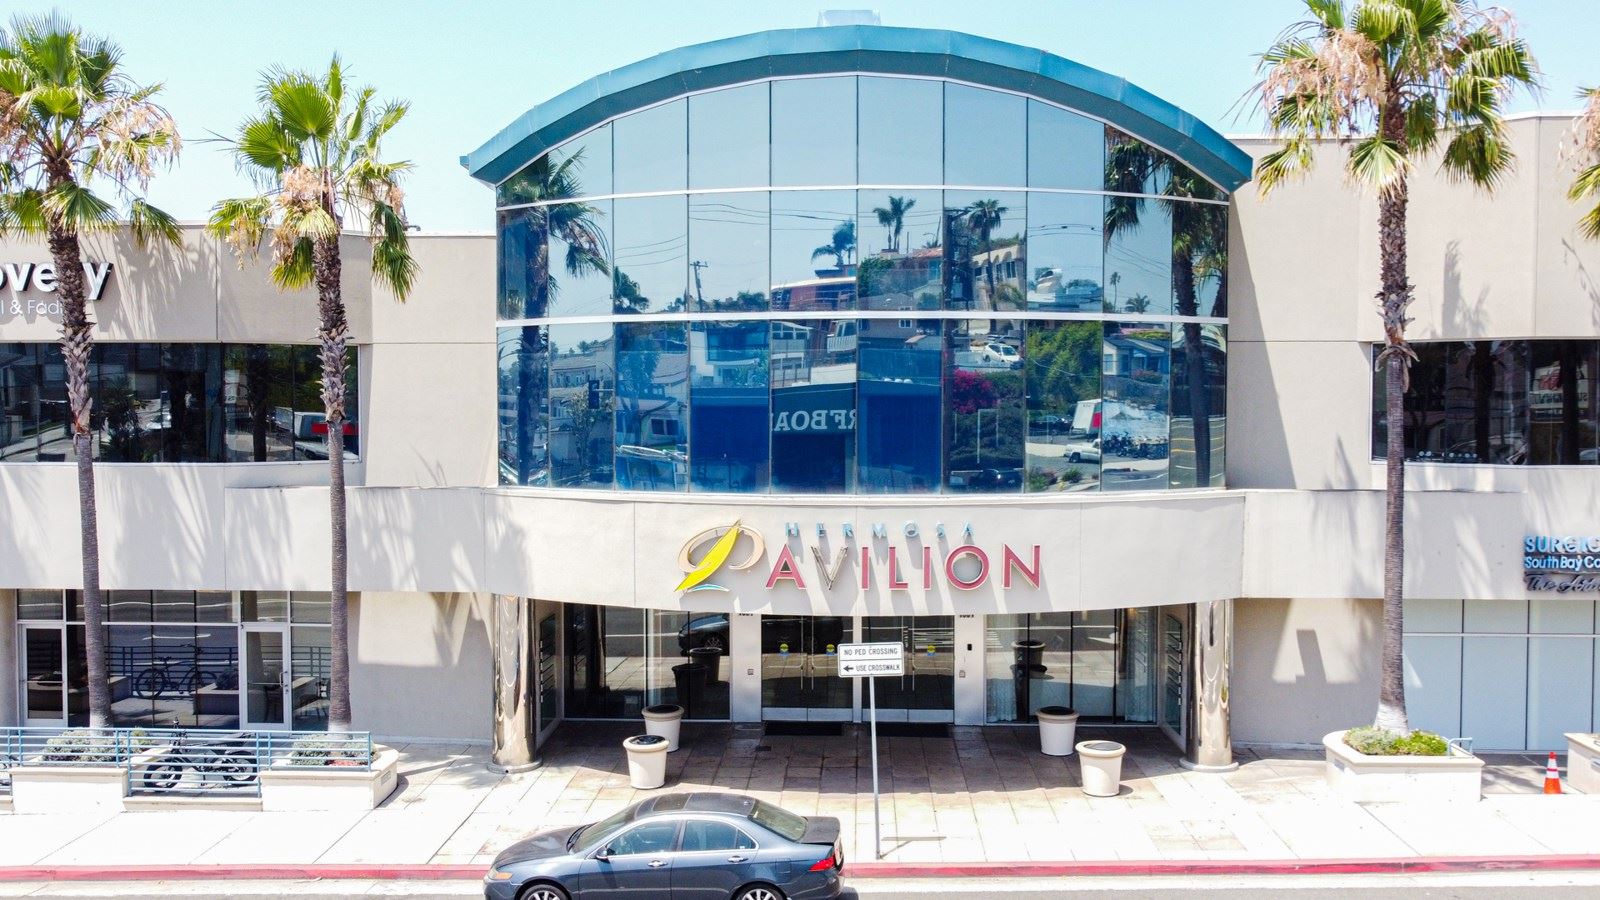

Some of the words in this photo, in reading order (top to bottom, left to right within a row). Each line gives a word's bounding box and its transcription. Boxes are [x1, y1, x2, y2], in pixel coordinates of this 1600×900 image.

[9, 299, 24, 316] &
[785, 520, 975, 538] HERMOSA
[1525, 556, 1559, 569] South
[1560, 556, 1582, 571] Bay
